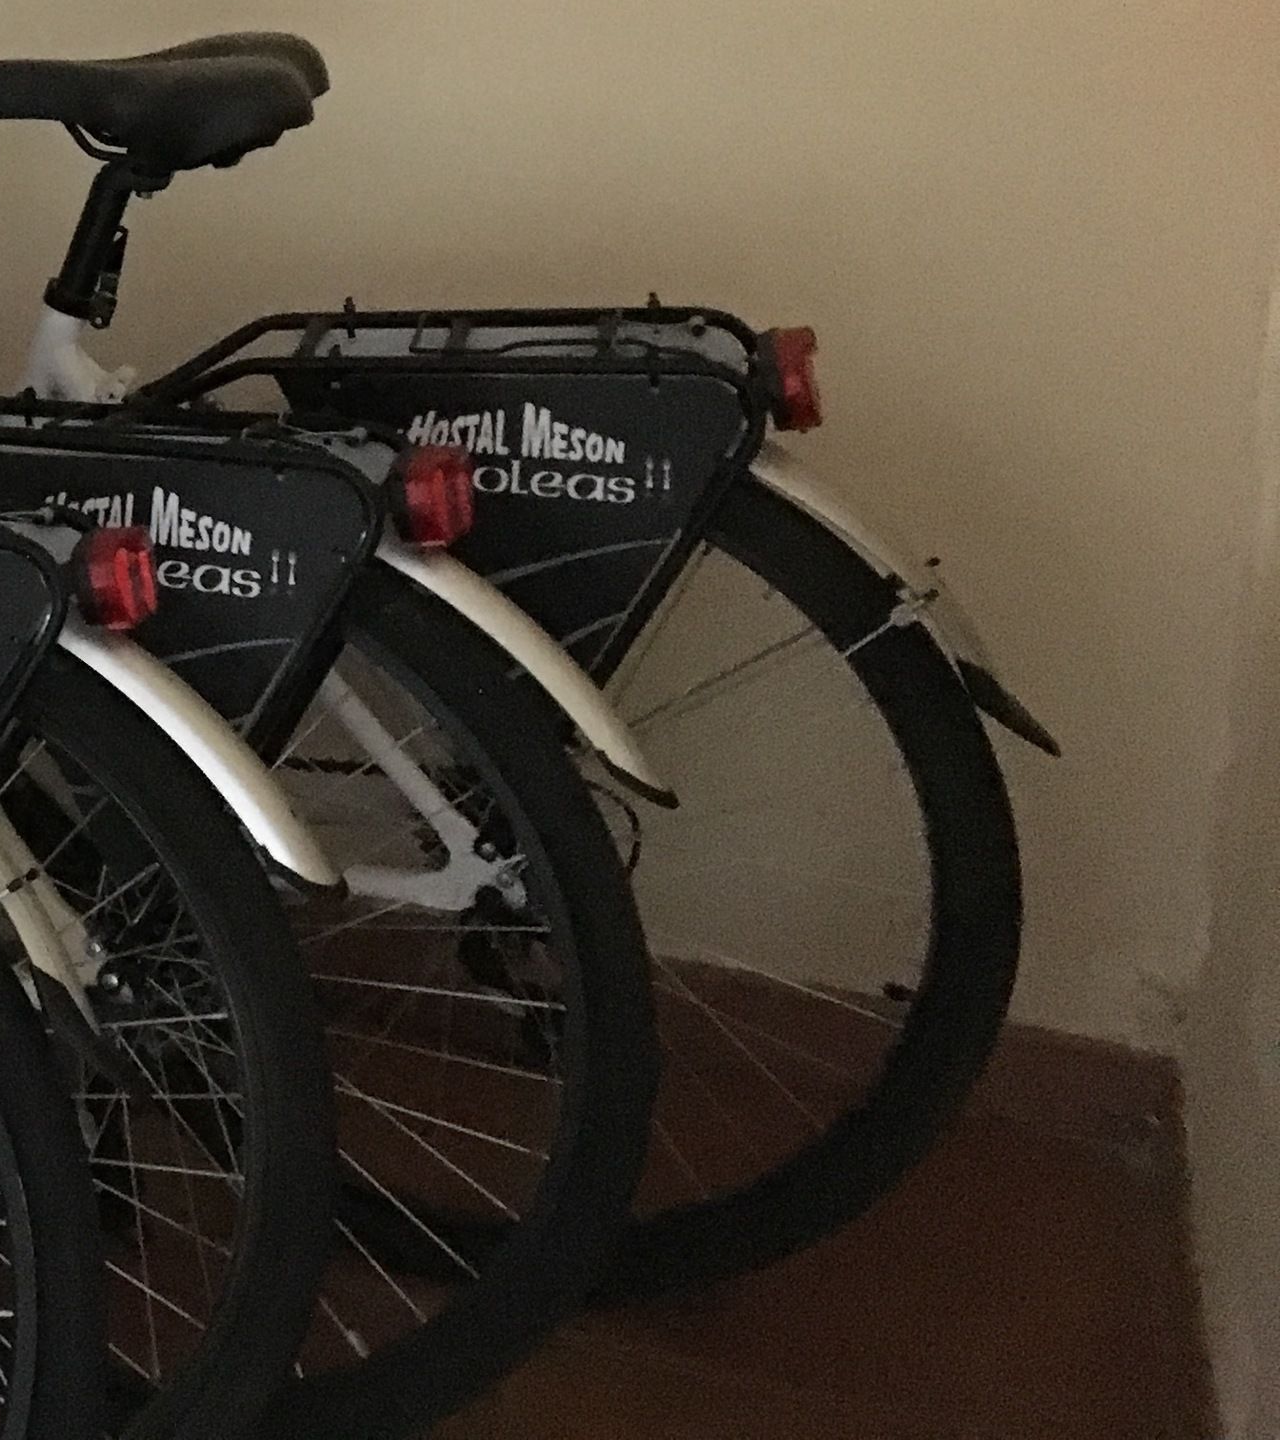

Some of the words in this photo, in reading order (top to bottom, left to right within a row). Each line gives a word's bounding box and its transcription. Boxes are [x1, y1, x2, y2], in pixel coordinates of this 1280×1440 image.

[406, 410, 509, 456] HOSTAL
[521, 402, 626, 464] MESON
[149, 486, 252, 556] MESON
